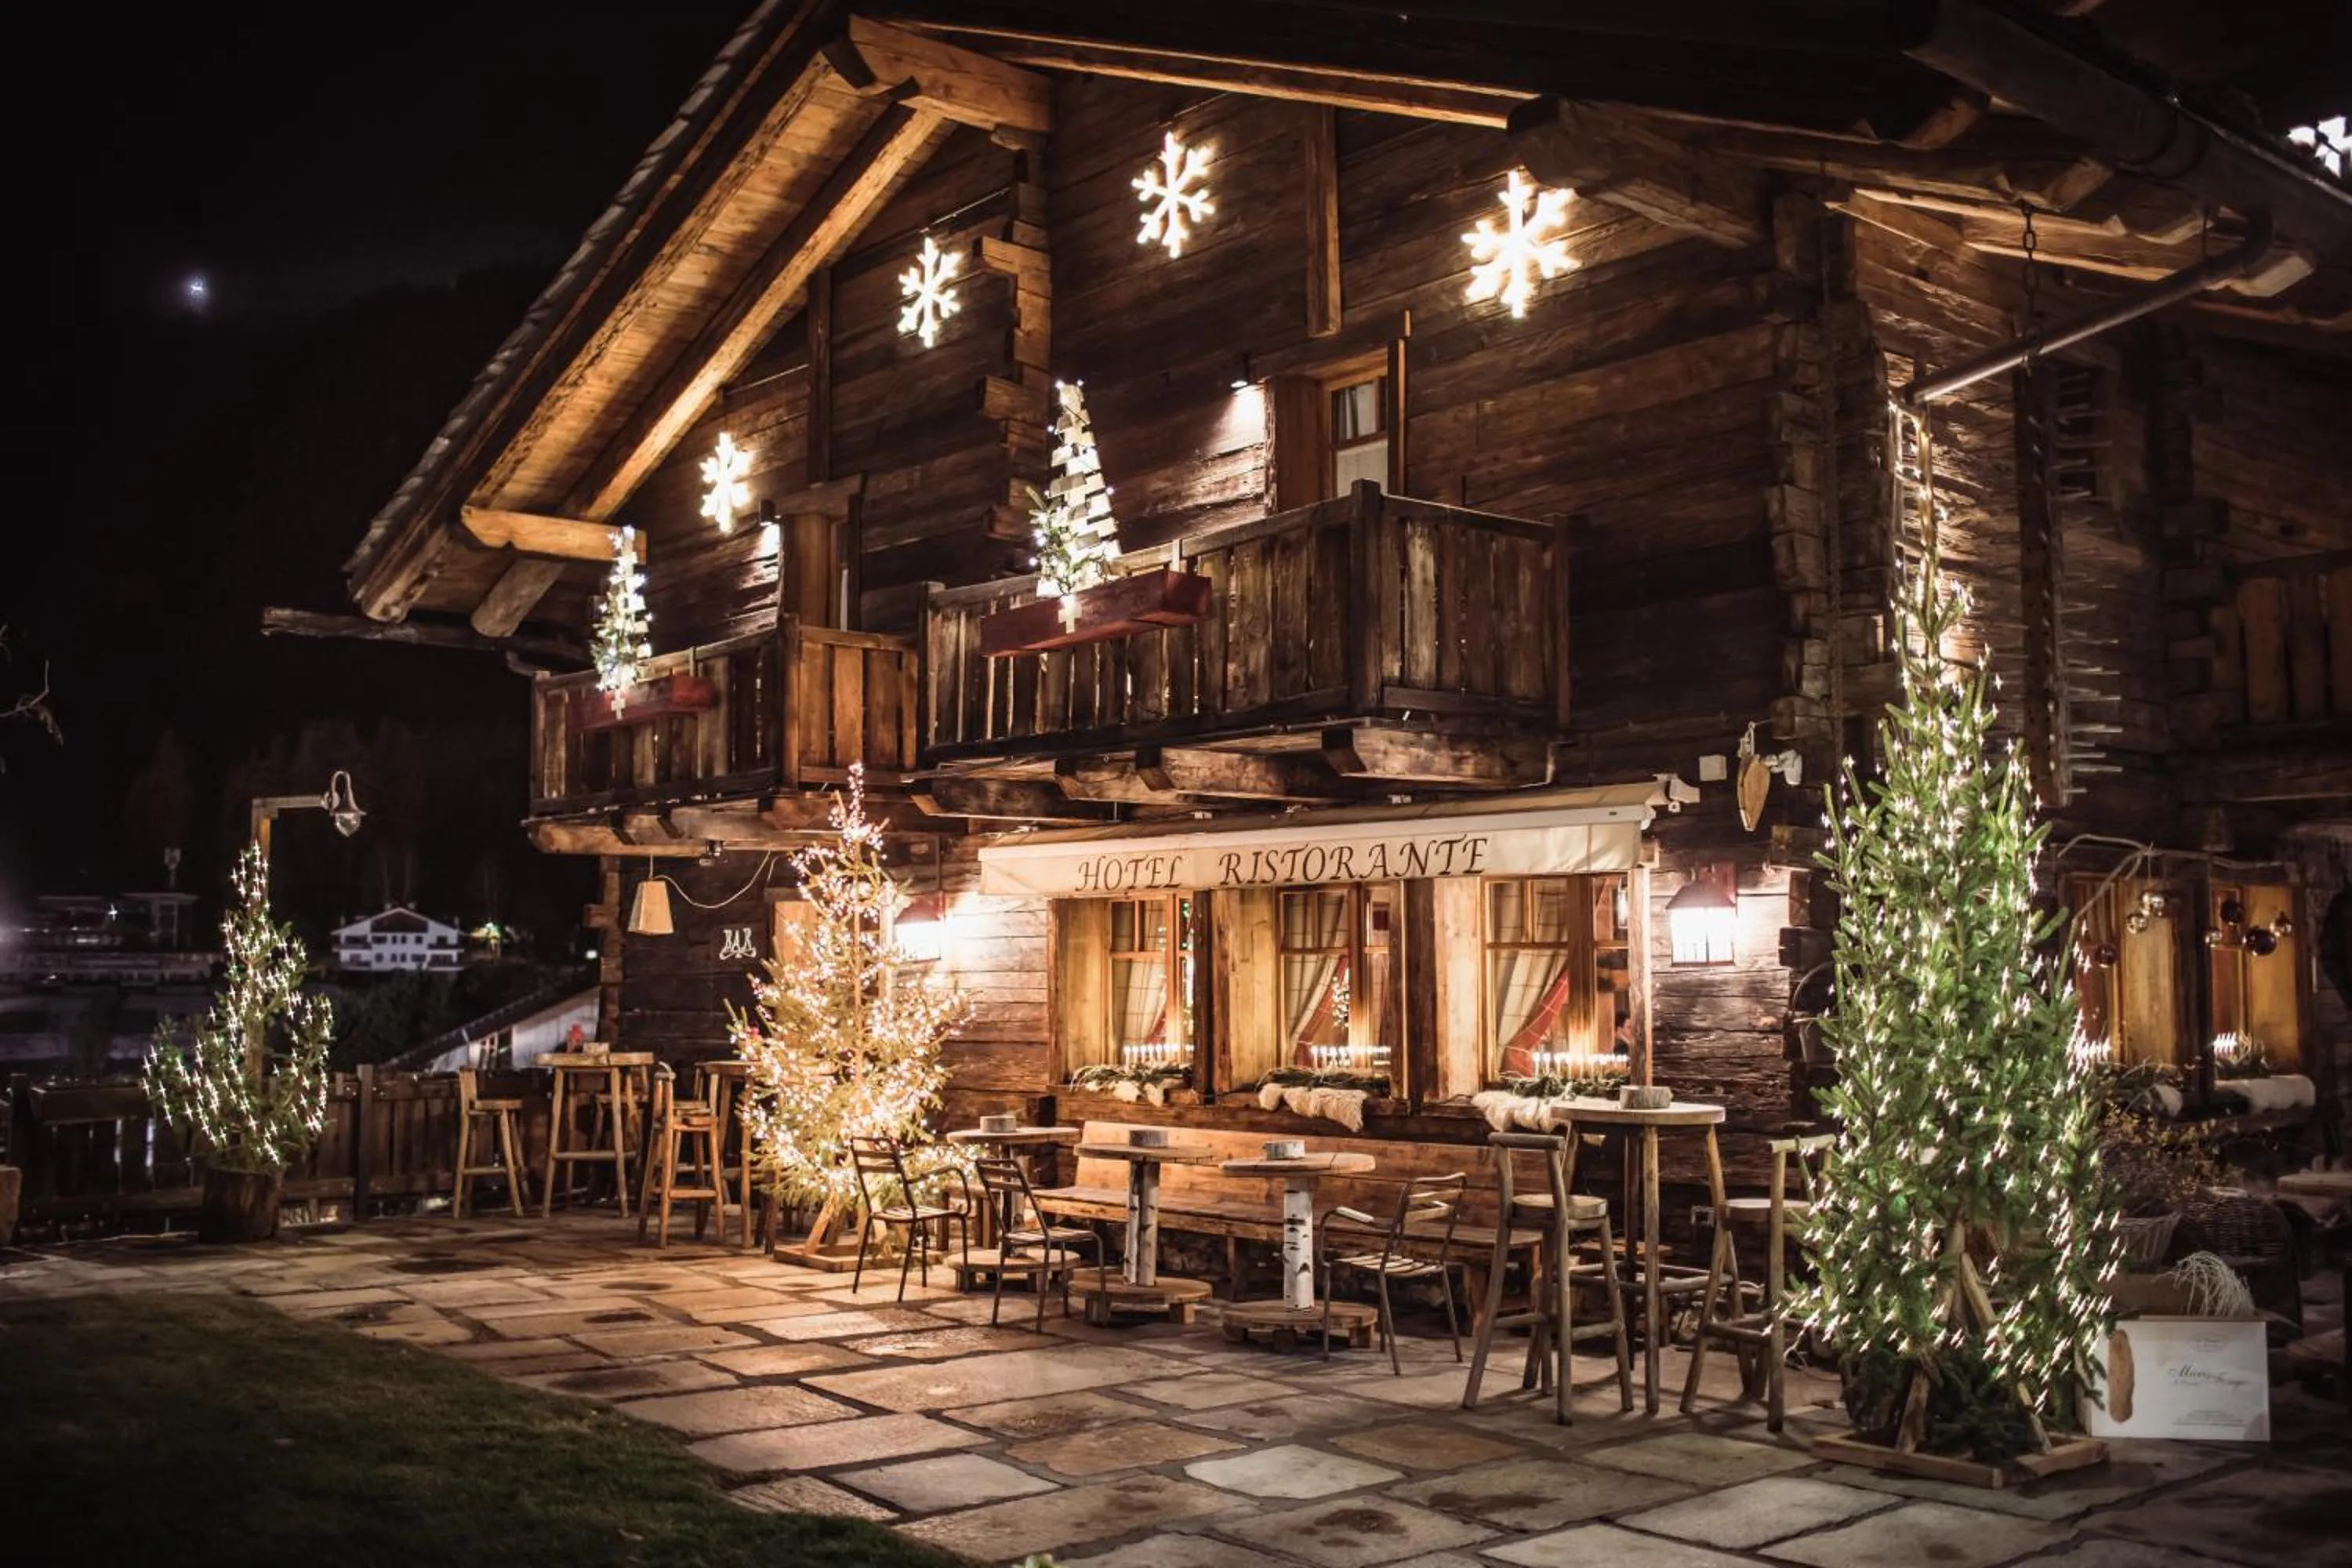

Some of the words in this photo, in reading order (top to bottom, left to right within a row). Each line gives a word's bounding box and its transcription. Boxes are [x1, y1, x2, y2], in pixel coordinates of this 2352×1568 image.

[1076, 855, 1184, 891] HOTEL
[1219, 833, 1487, 886] RISTORANTE
[719, 927, 757, 960] BAR
